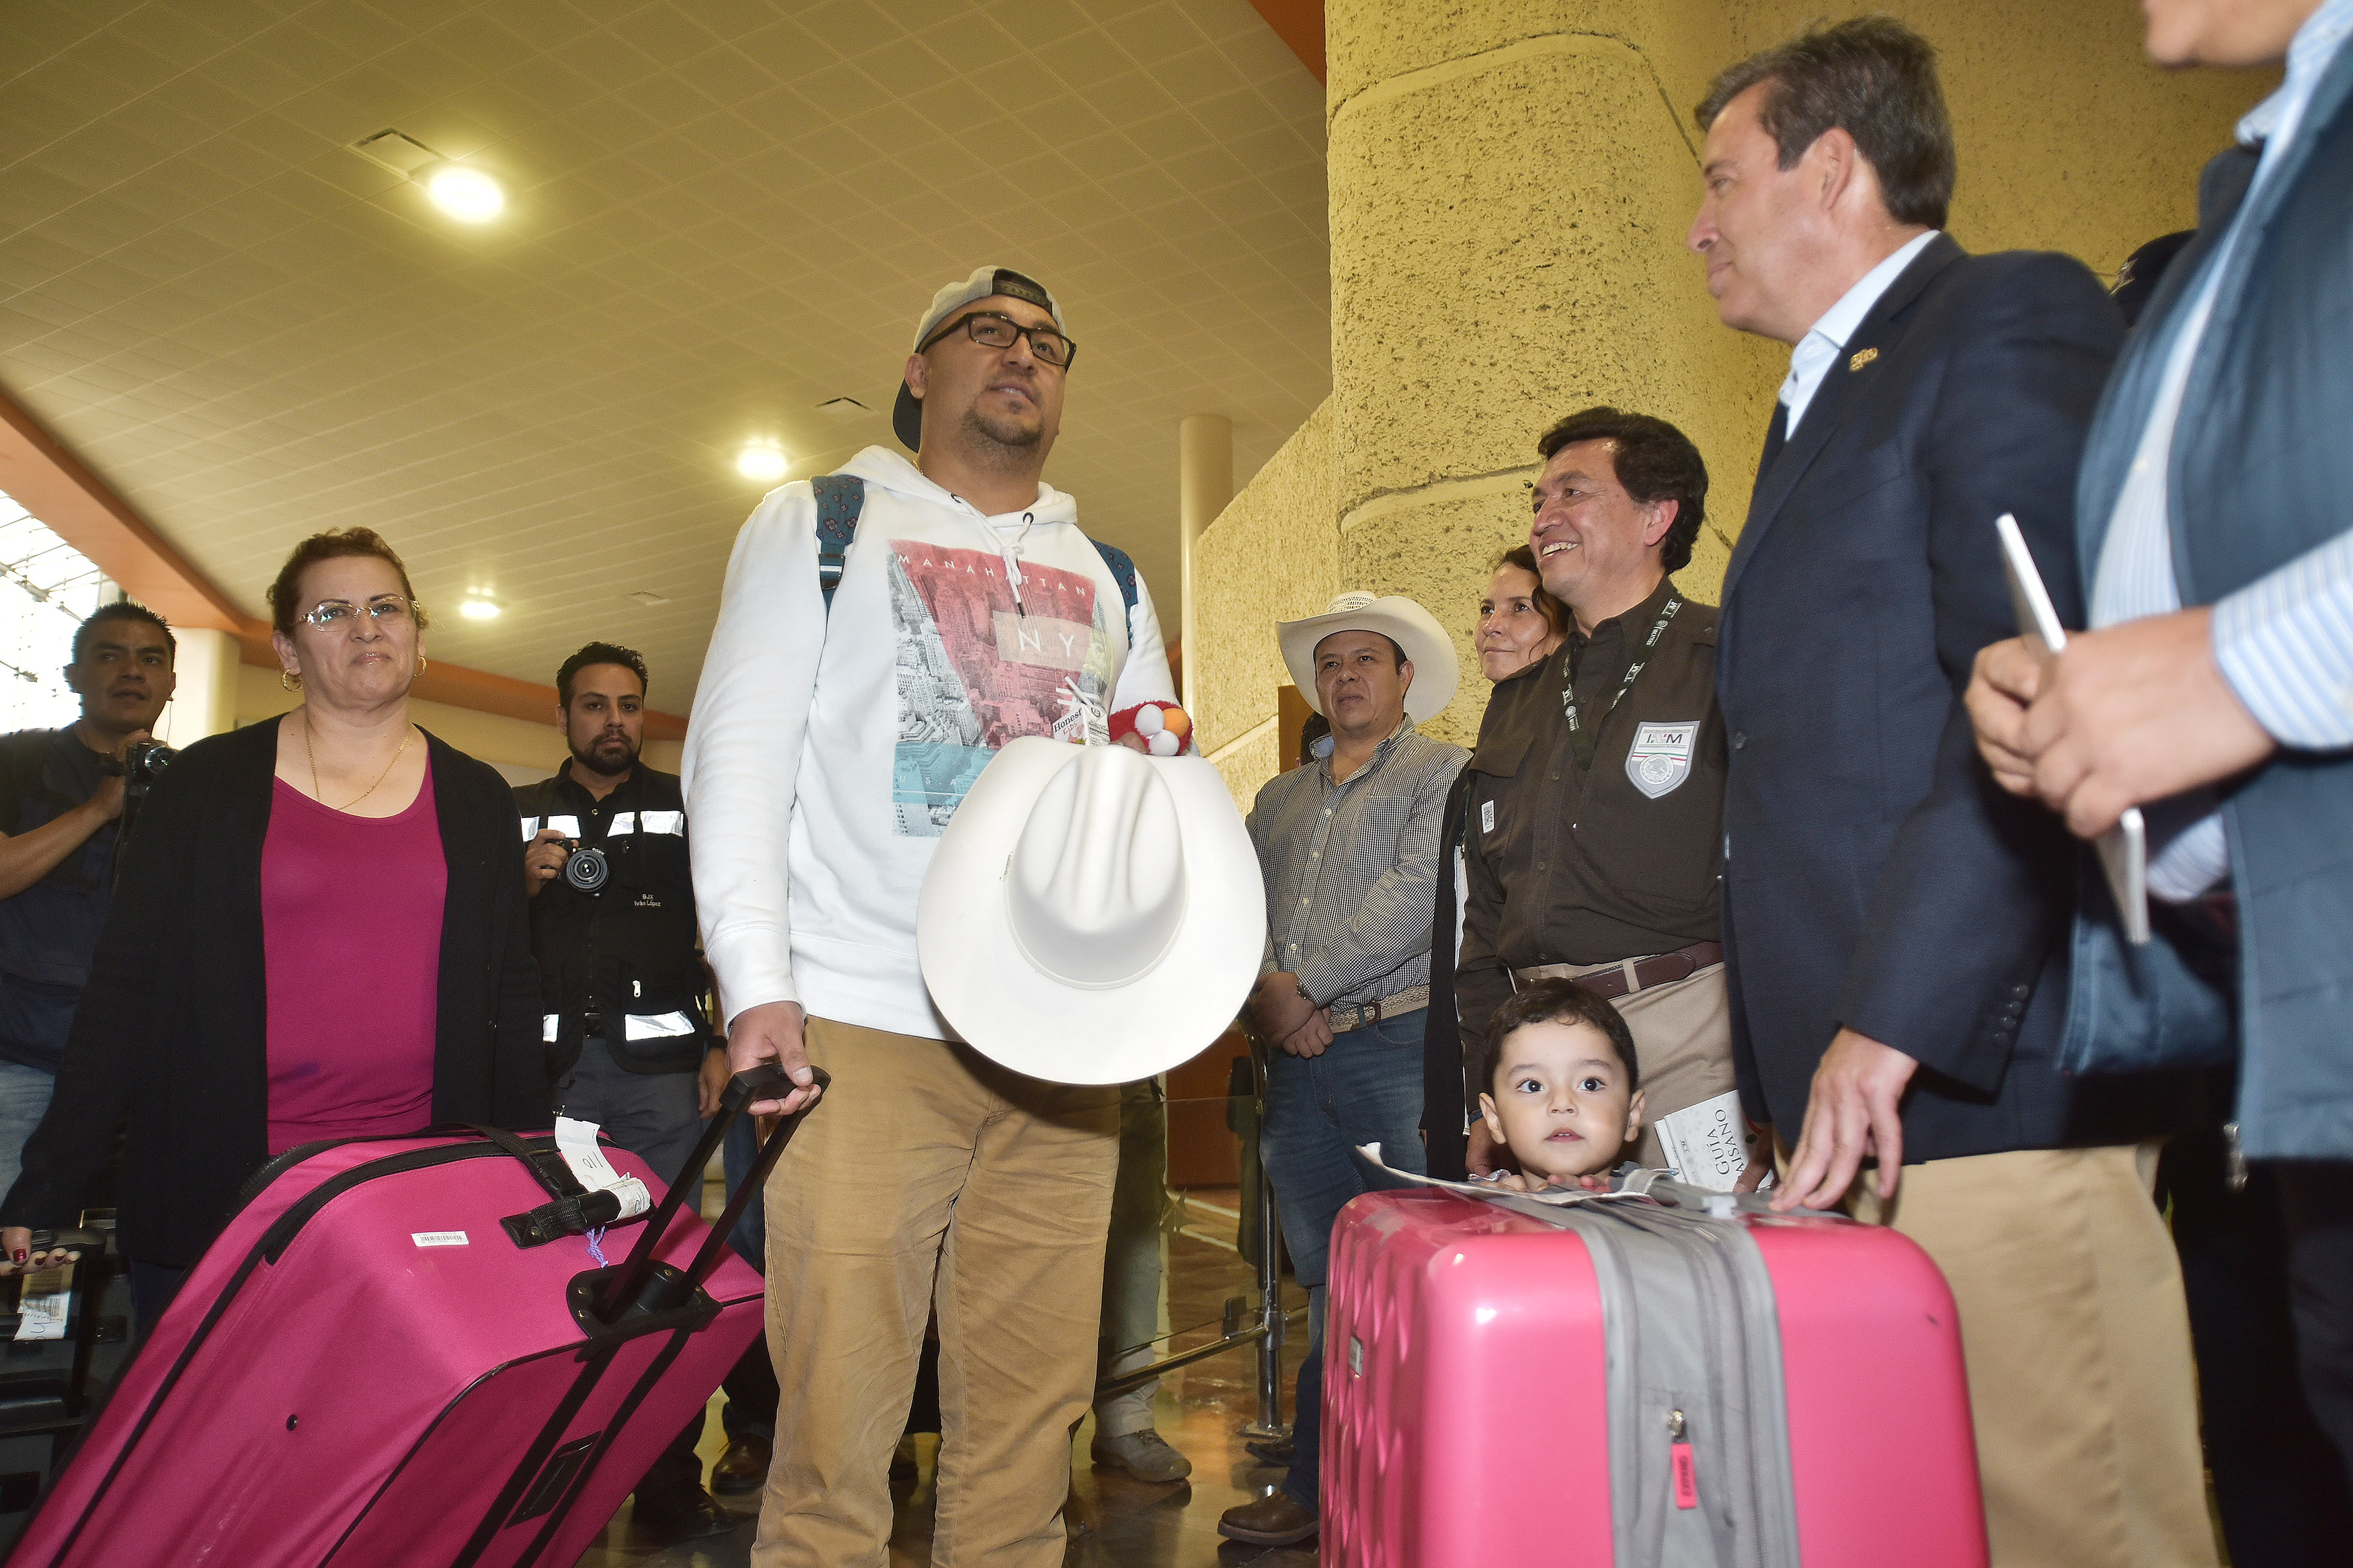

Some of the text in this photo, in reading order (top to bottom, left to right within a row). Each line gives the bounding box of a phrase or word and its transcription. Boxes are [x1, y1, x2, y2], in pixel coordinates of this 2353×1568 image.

[898, 555, 1086, 596] MANAHTTAN
[1053, 707, 1082, 733] Honest
[1707, 1128, 1730, 1175] GUÍA
[1715, 1109, 1745, 1180] AISANO
